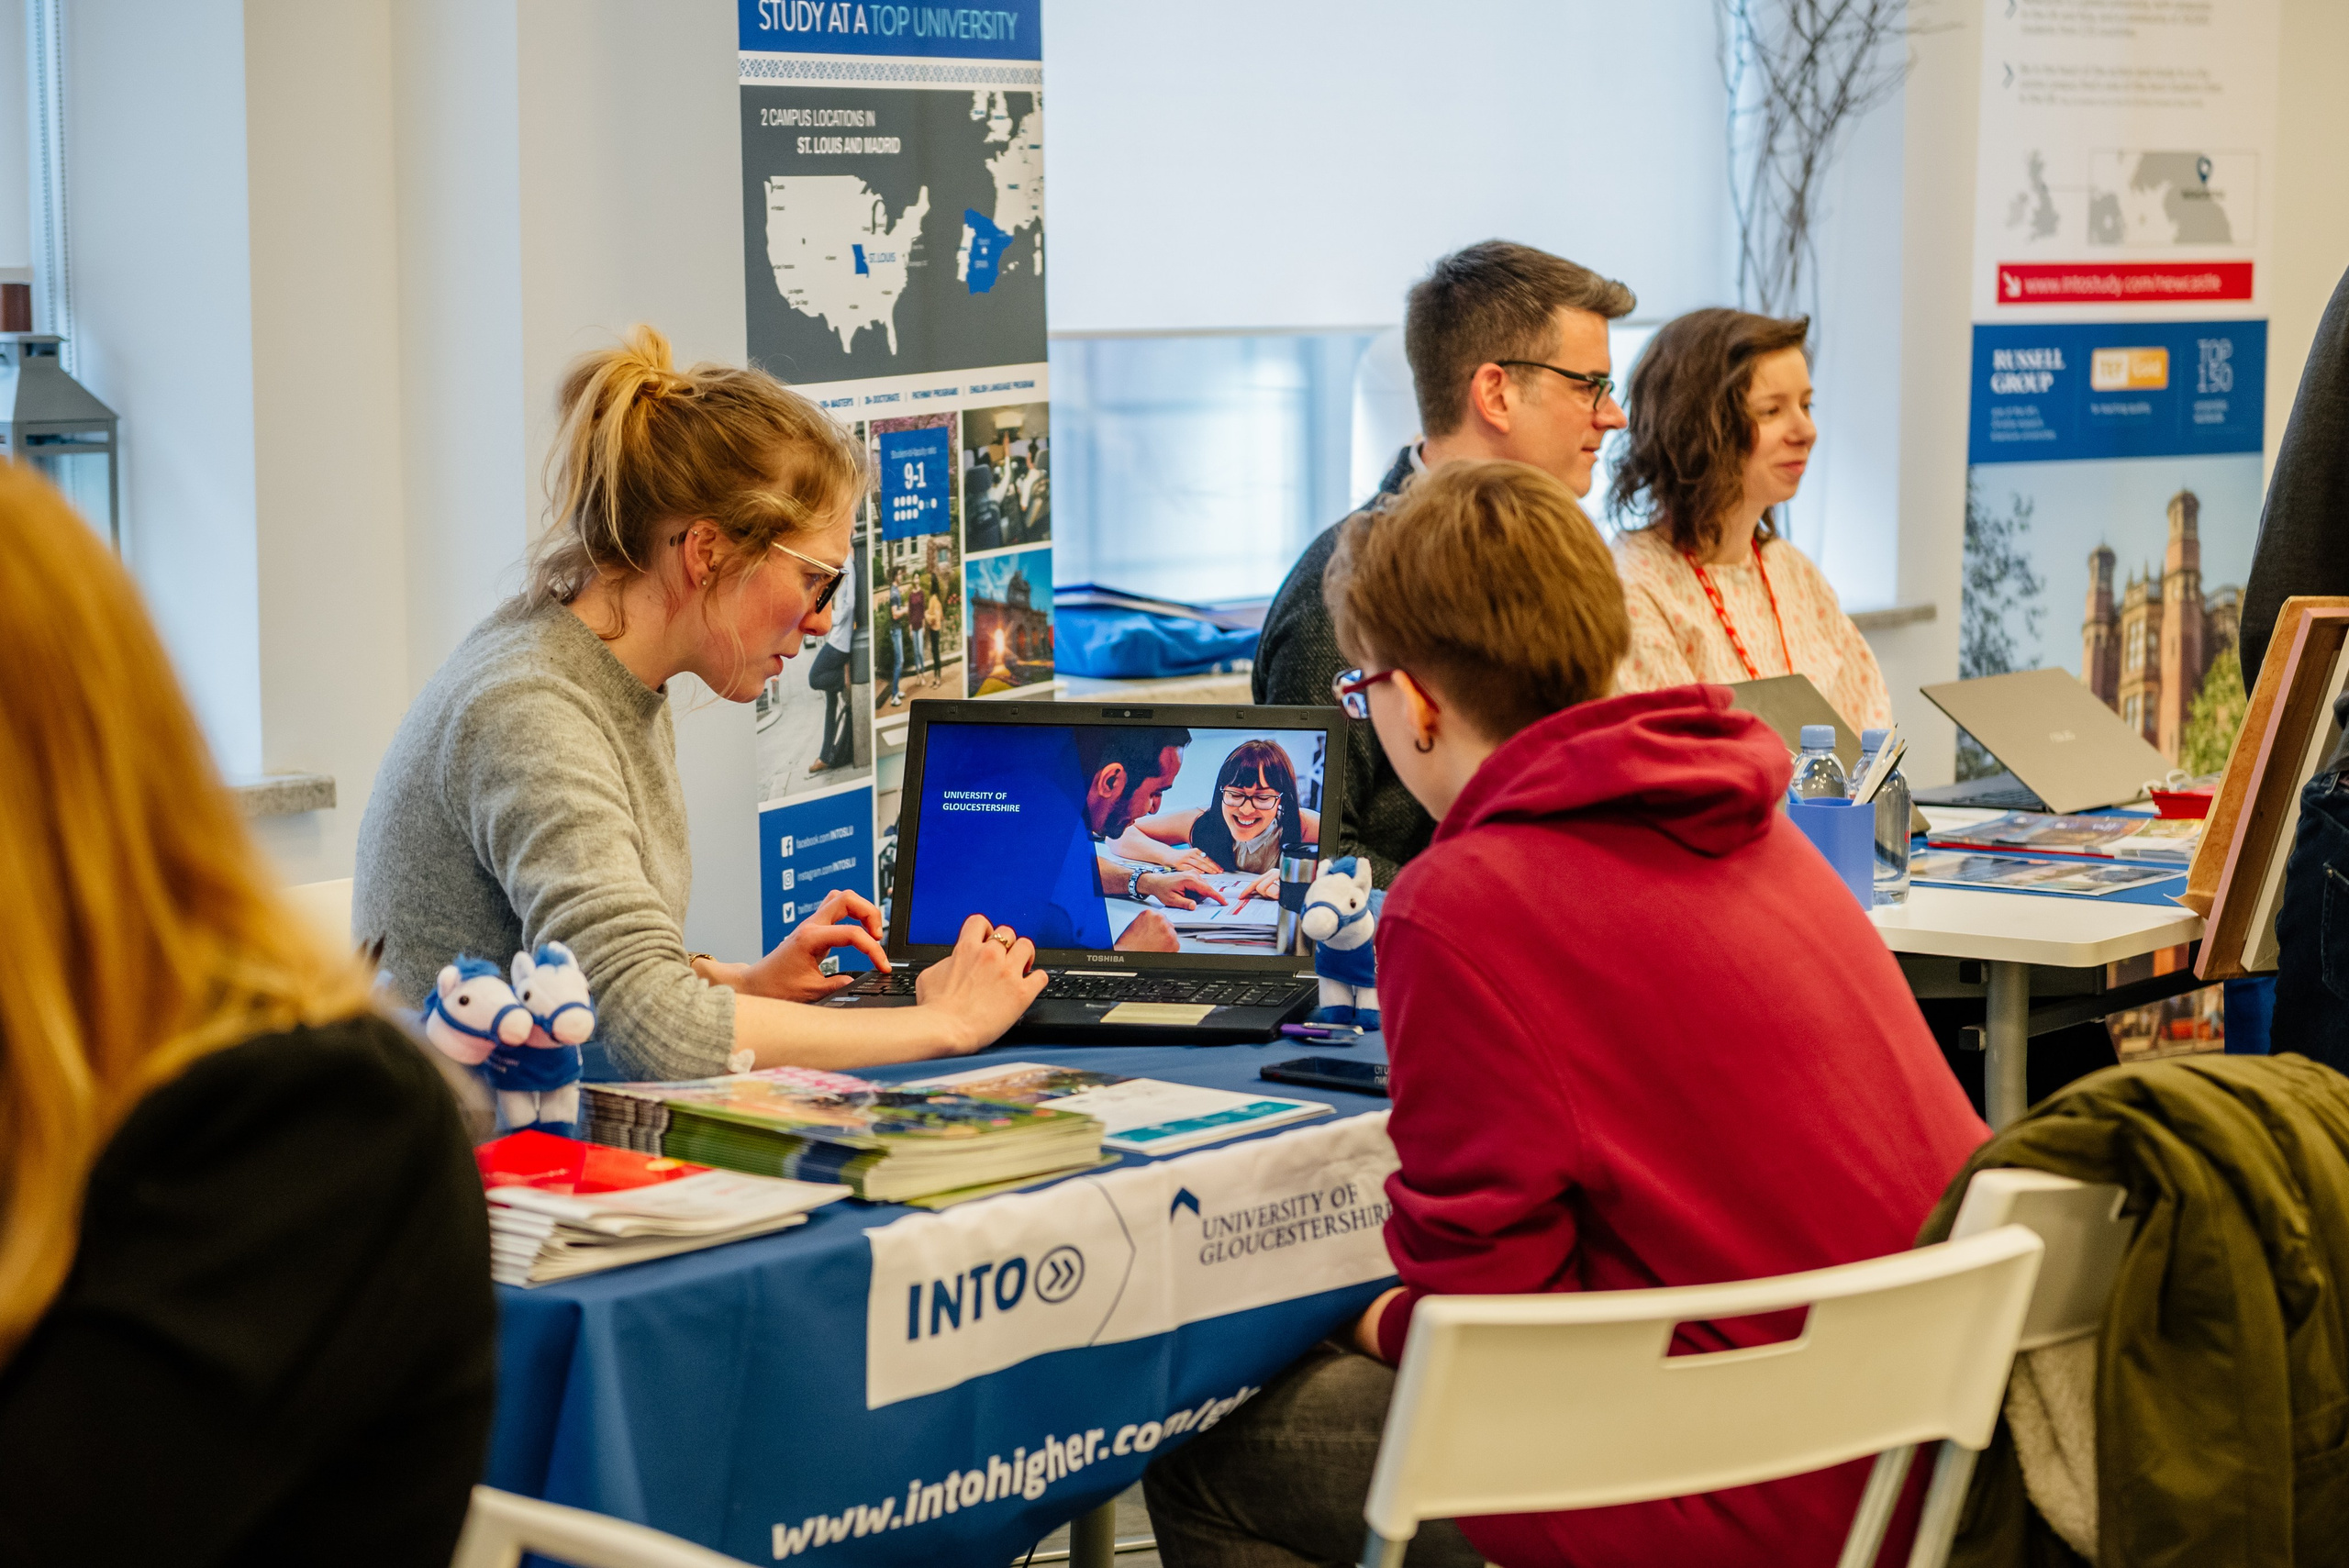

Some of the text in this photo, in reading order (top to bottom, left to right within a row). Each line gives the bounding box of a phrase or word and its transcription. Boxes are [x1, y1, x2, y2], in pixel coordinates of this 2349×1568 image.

[758, 0, 1019, 39] STUDY AT A TOP UNIVERSITY
[760, 108, 876, 127] 2 CAMPUS LOCATIONS IN
[796, 137, 901, 154] ST. LOUIS AND MADRID
[1993, 347, 2066, 371] RUSSELL
[2197, 337, 2233, 361] TOP
[1989, 371, 2054, 395] GROUP
[2197, 361, 2233, 393] 150
[904, 462, 927, 490] 9-1
[942, 802, 1020, 813] GLOUCESTERSHIRE
[943, 791, 1008, 800] UNIVERSITY OF
[1086, 954, 1125, 962] TOSHIBA
[1202, 1182, 1358, 1240] UNIVERSITY OF
[907, 1256, 1028, 1342] INTO
